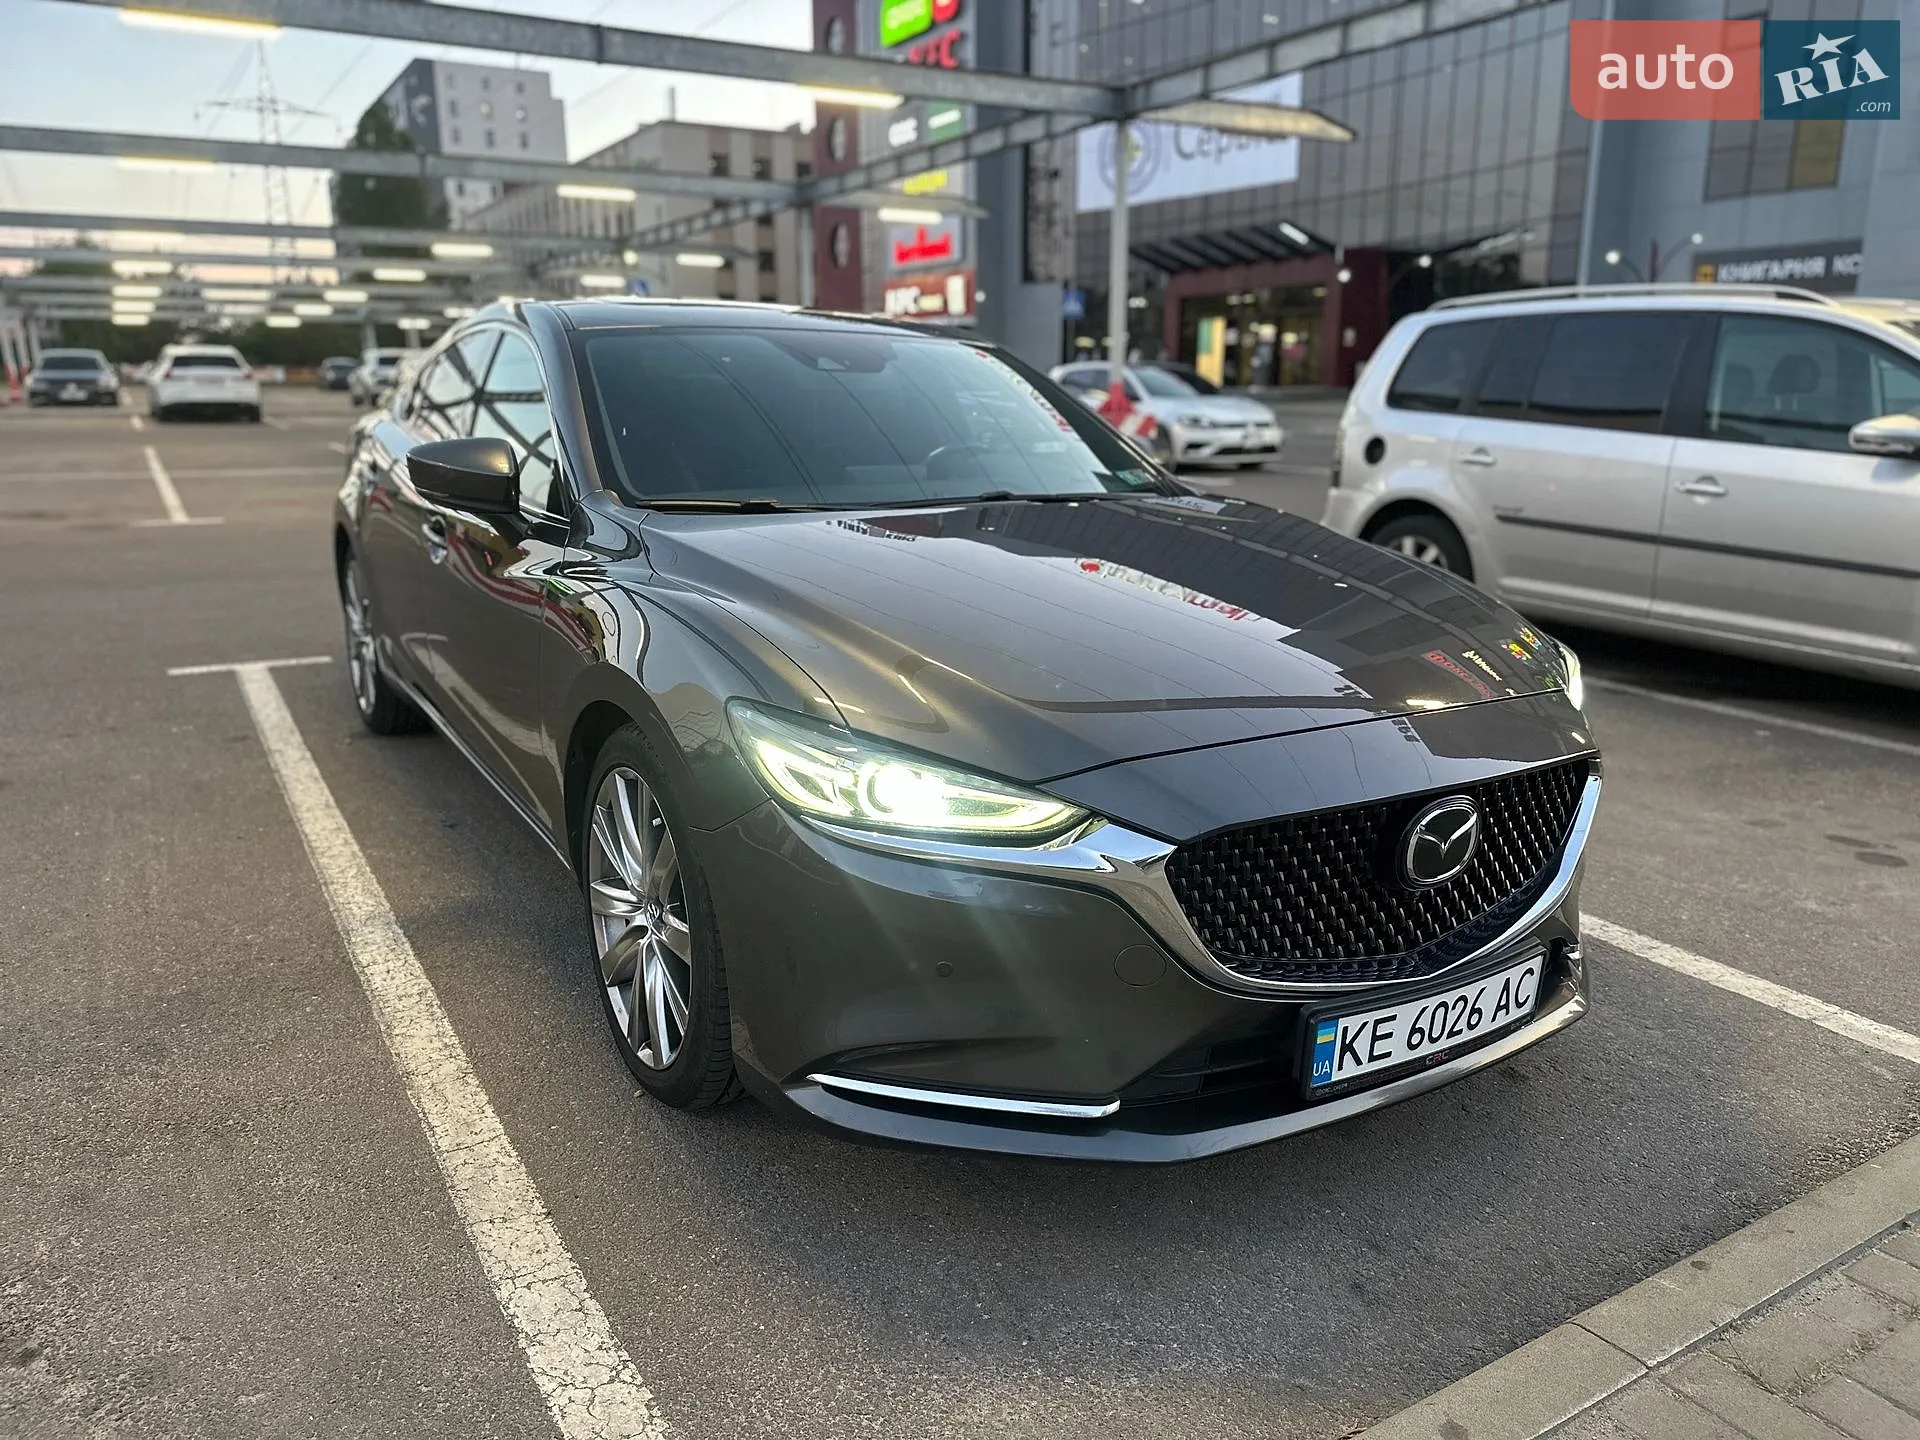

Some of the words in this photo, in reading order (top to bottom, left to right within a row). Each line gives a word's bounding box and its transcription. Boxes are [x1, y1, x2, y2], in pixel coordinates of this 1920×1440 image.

[1337, 1013, 1398, 1072] KE
[1406, 986, 1488, 1051] 6026
[1490, 967, 1535, 1022] AC
[1312, 1060, 1331, 1077] UA
